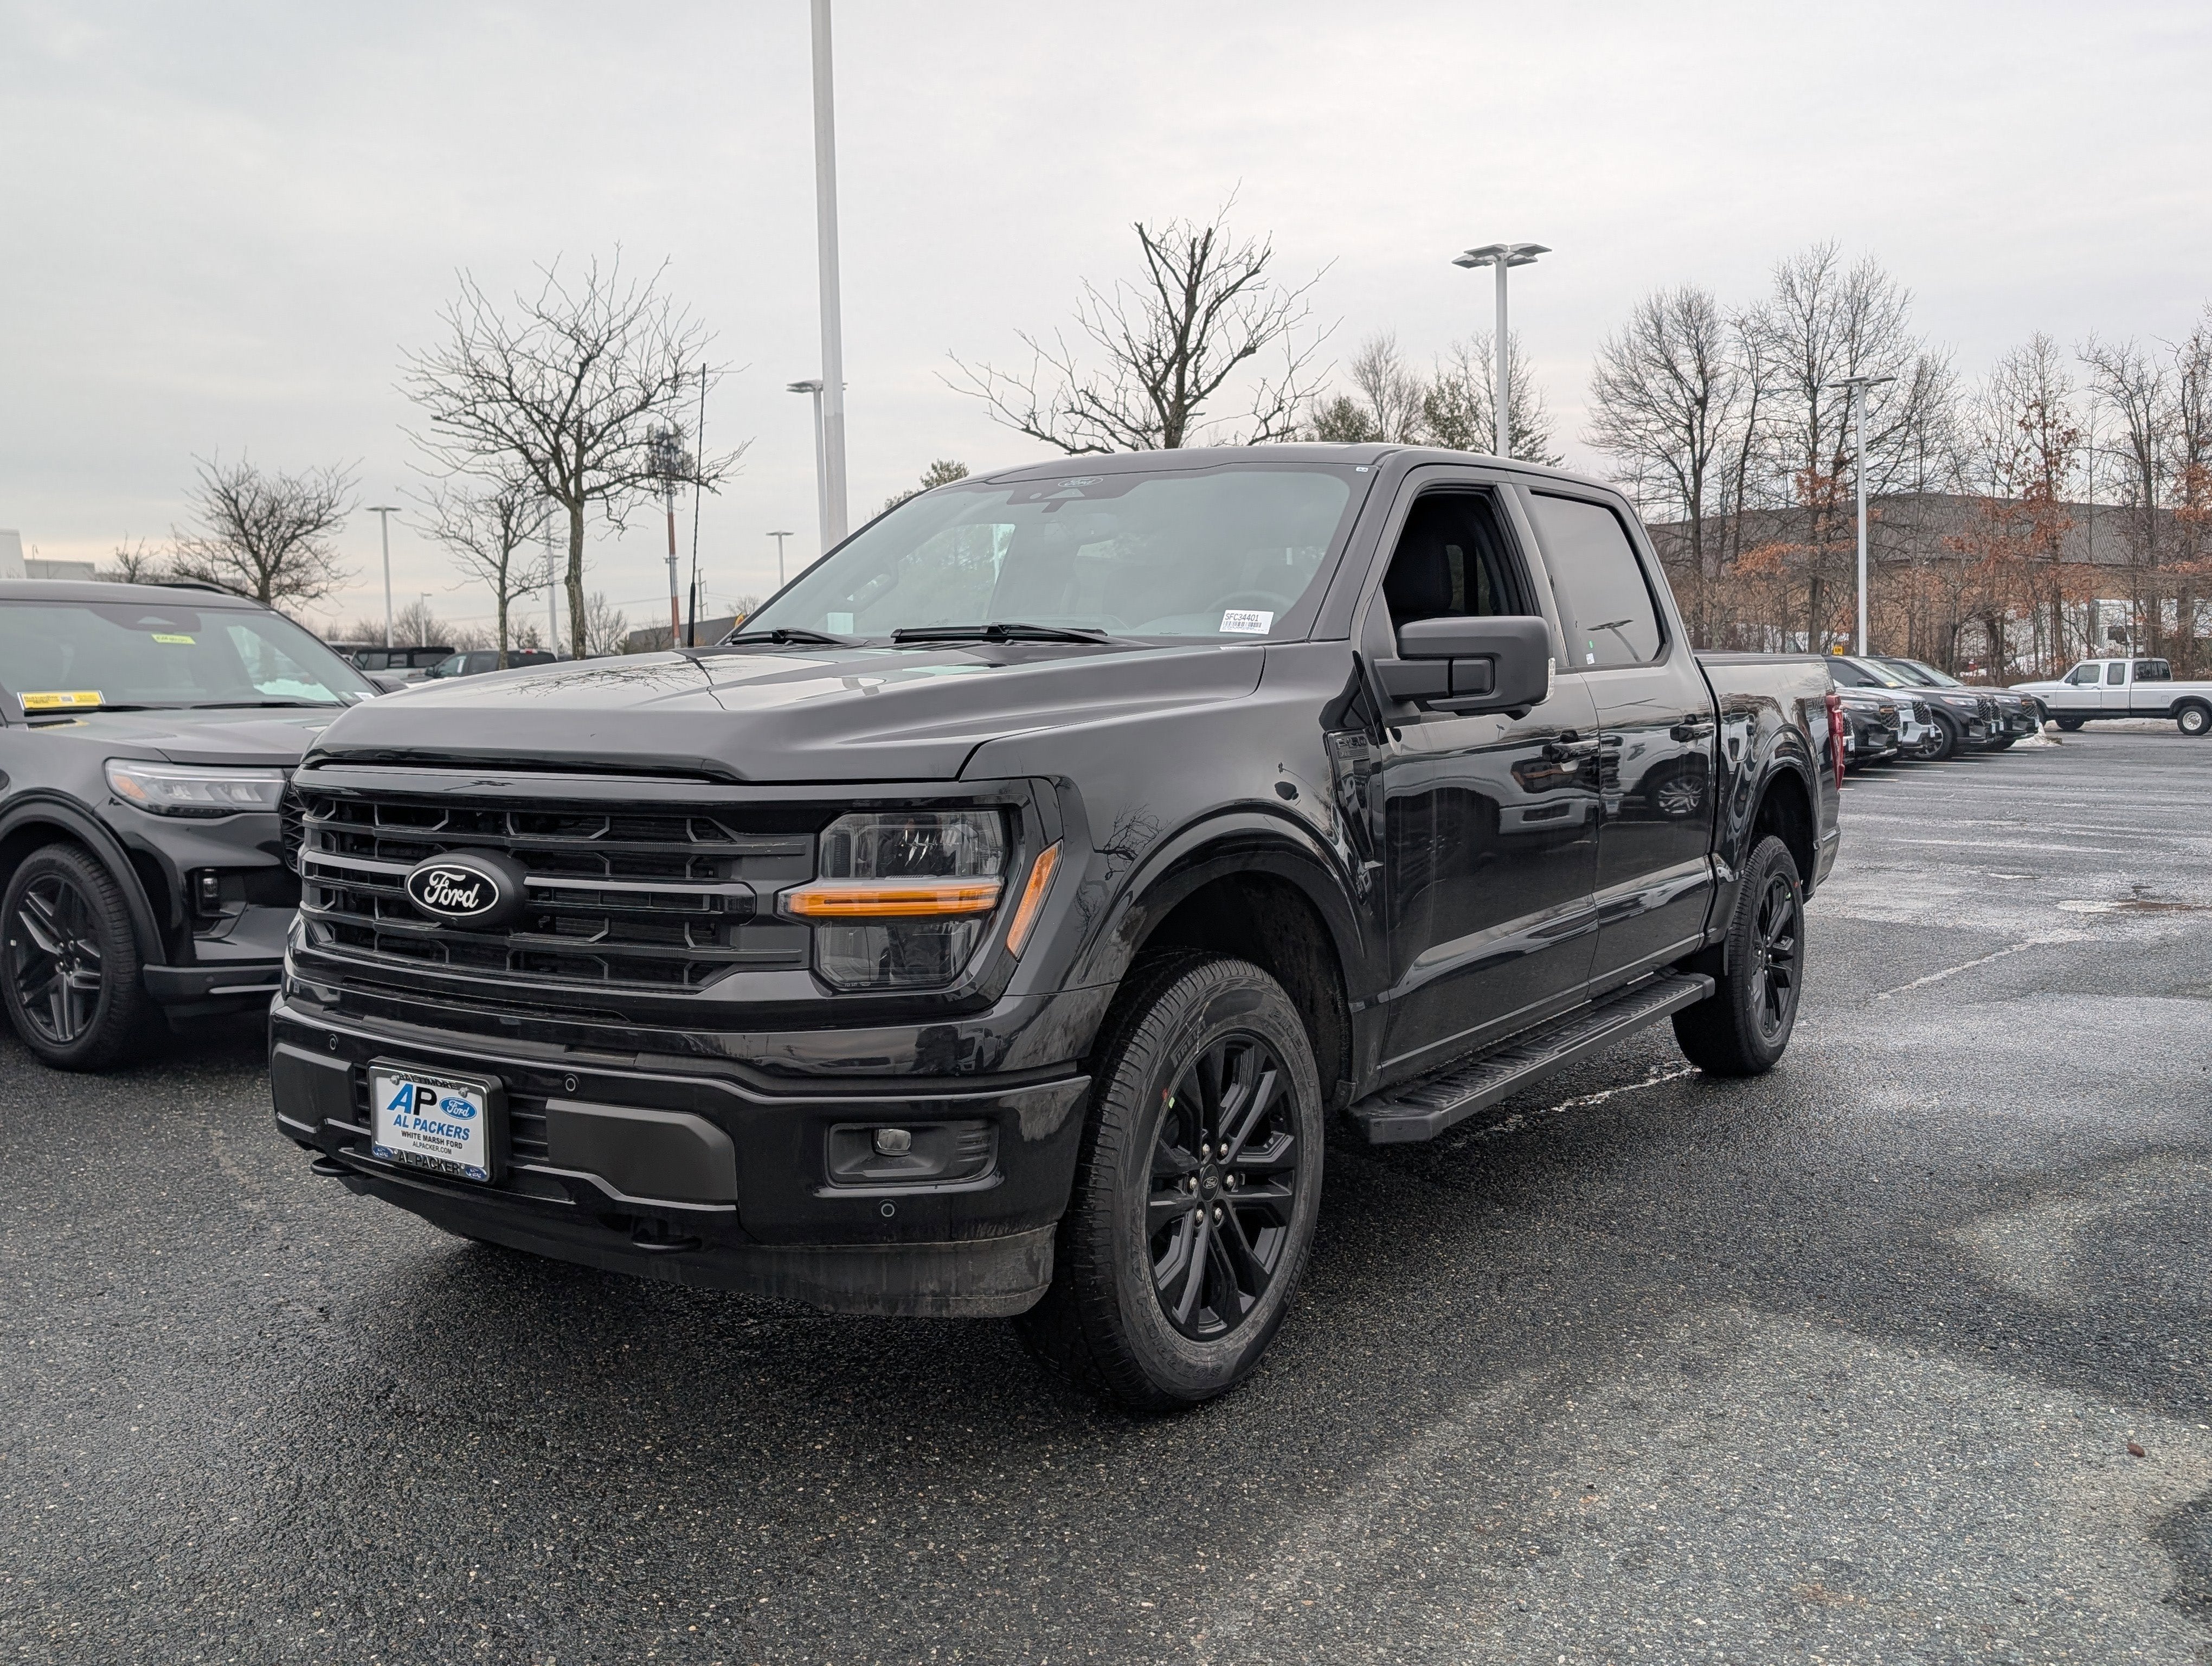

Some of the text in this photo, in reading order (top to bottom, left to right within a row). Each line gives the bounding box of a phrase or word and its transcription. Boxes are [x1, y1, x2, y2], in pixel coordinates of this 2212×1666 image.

[1225, 613, 1259, 621] SFC34401
[423, 870, 480, 908] Ford
[399, 1072, 458, 1089] BALTIMORE
[387, 1083, 438, 1116] AP
[446, 1099, 470, 1117] Ford
[393, 1114, 470, 1141] AL PACKERS
[401, 1130, 463, 1149] WHITE MARSH FORD
[412, 1140, 452, 1155] ALPACKER.COM
[398, 1150, 460, 1175] AL PACKER
